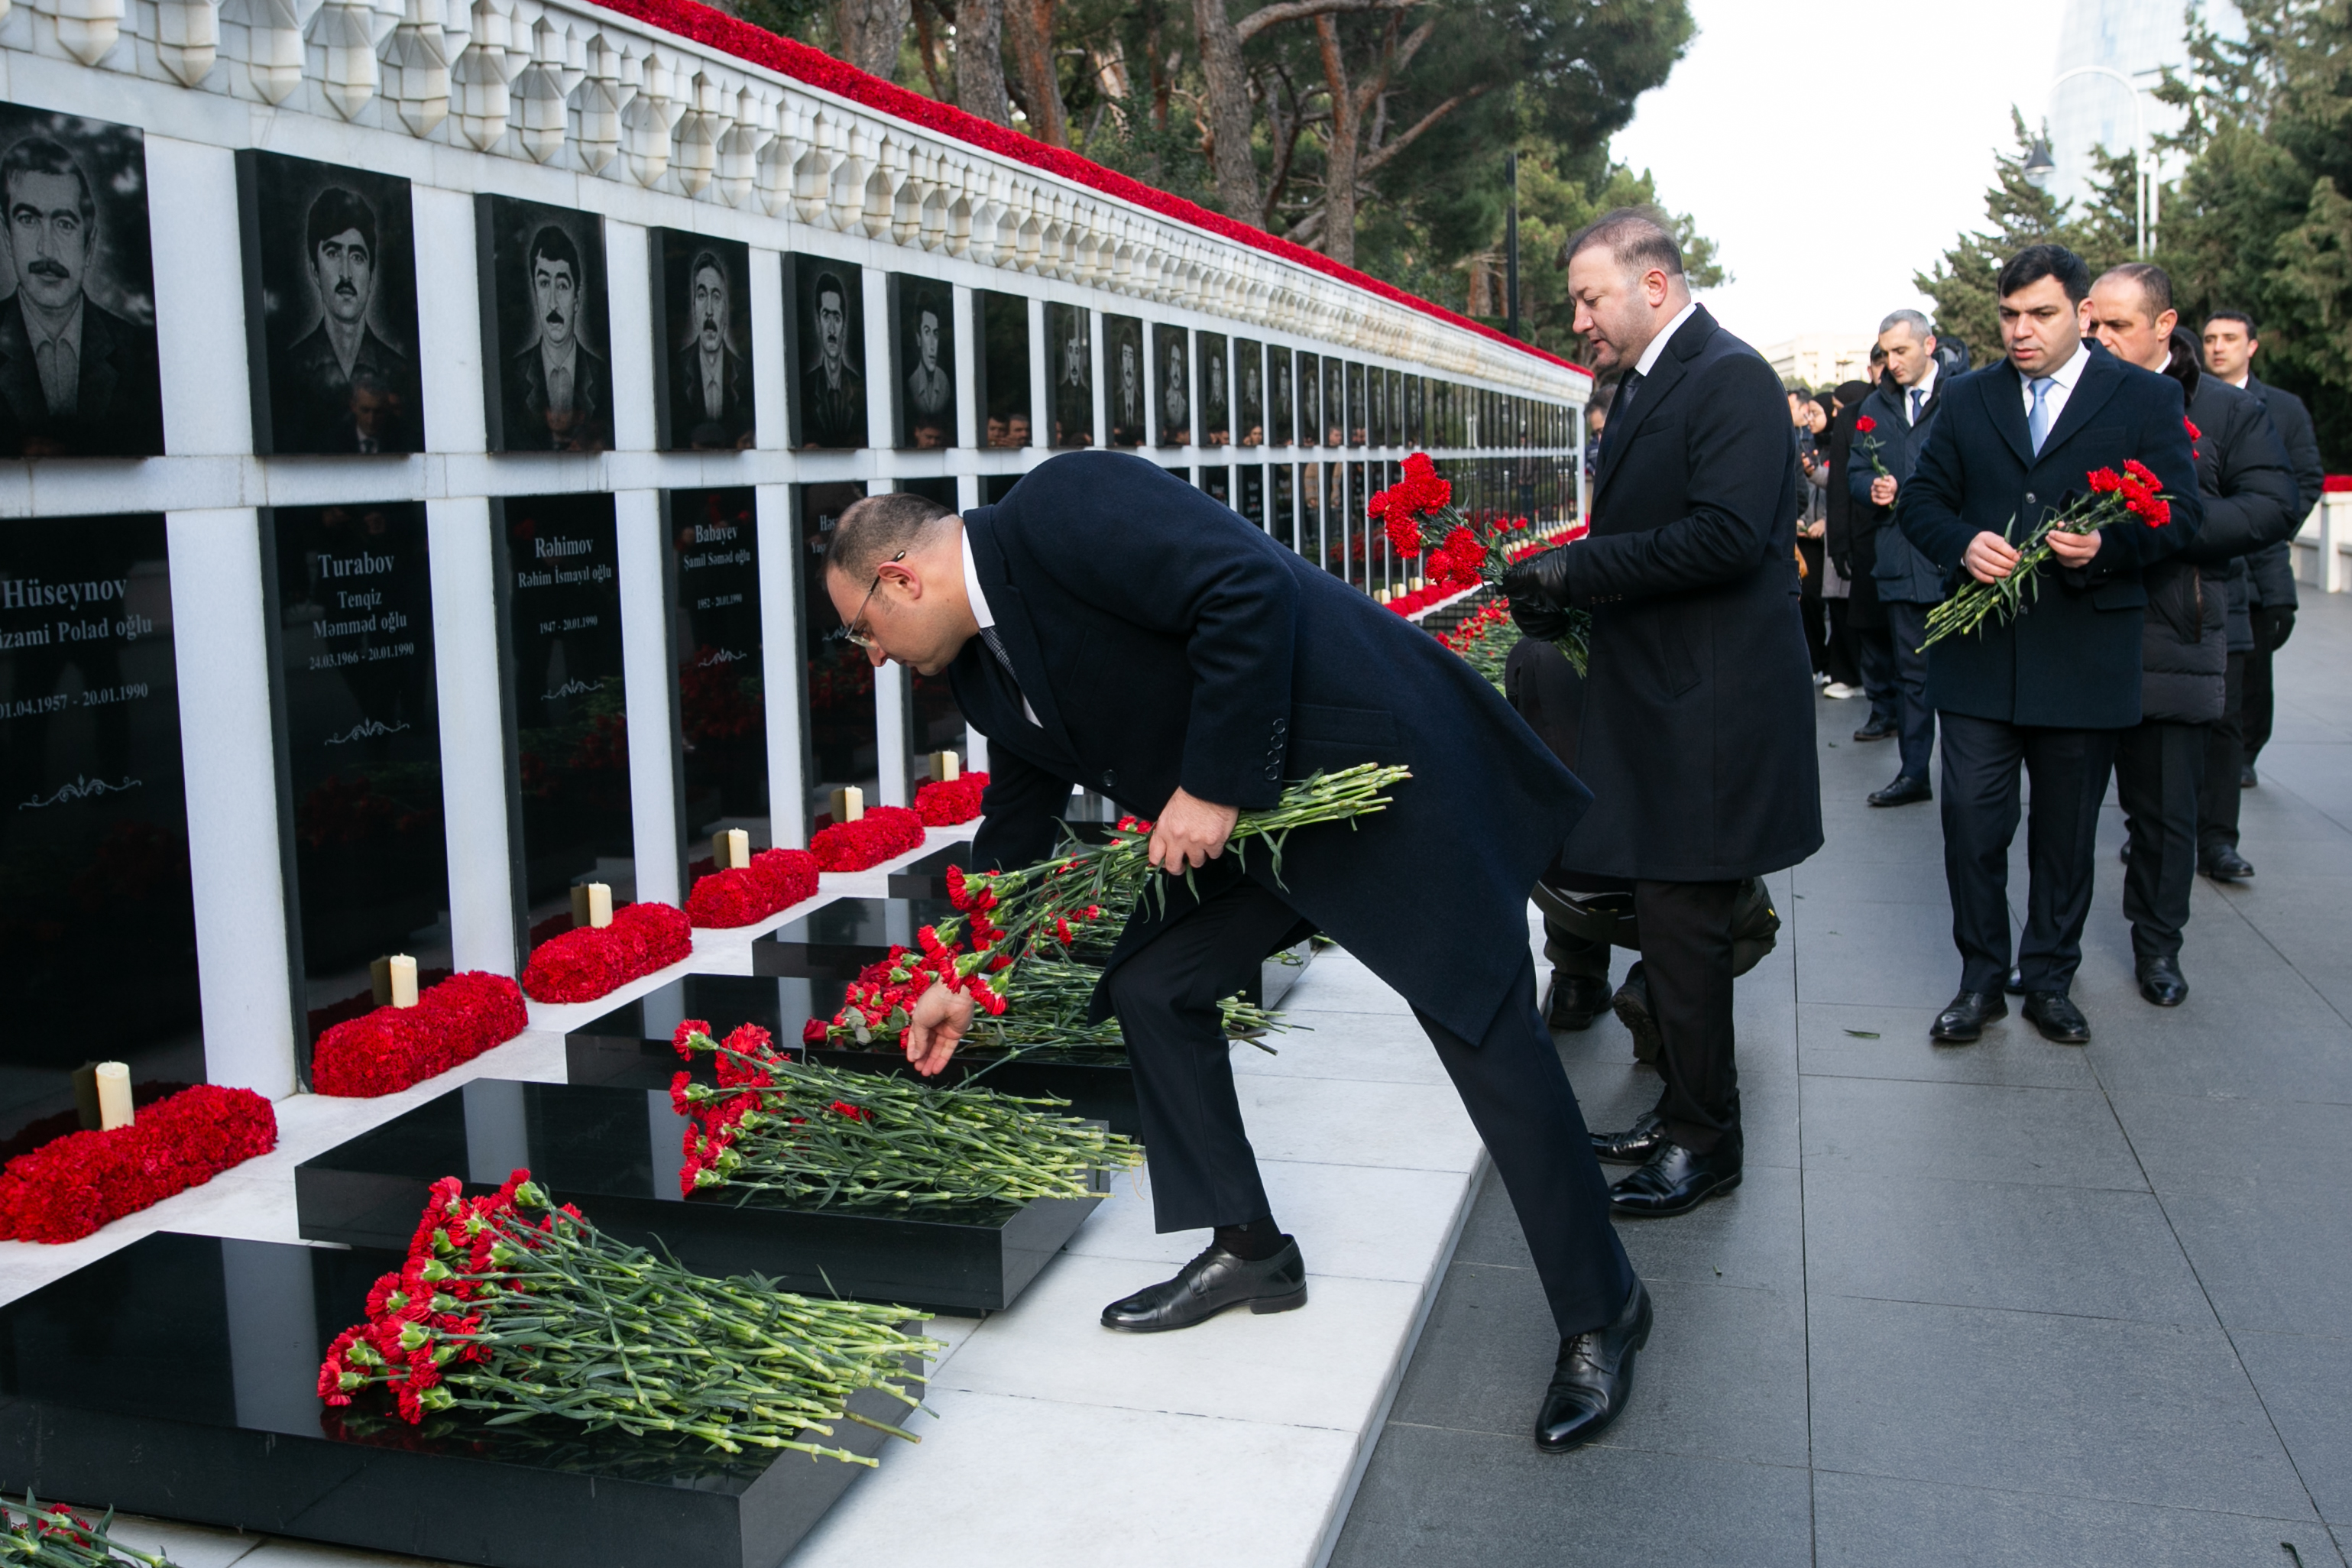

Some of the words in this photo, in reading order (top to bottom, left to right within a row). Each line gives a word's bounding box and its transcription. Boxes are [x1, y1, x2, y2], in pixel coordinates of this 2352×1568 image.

[695, 523, 738, 546] Babayev
[536, 536, 593, 559] Rəhimov
[318, 552, 394, 579] Turabov
[684, 552, 706, 572] Şamil
[735, 548, 751, 566] oğlu
[518, 571, 552, 588] Rəhim
[592, 563, 612, 584] oğlu
[3, 578, 127, 611] Hüseynov
[337, 588, 382, 611] Tenqiz
[58, 617, 109, 643] Polad
[115, 614, 153, 640] oğlu
[313, 614, 376, 639] Məmməd
[381, 611, 408, 634] oğlu
[562, 614, 598, 631] 20.01.1990
[309, 650, 358, 671] 24.03.1966
[369, 643, 414, 661] 20.01.1990
[83, 683, 147, 707] 20.01.1990
